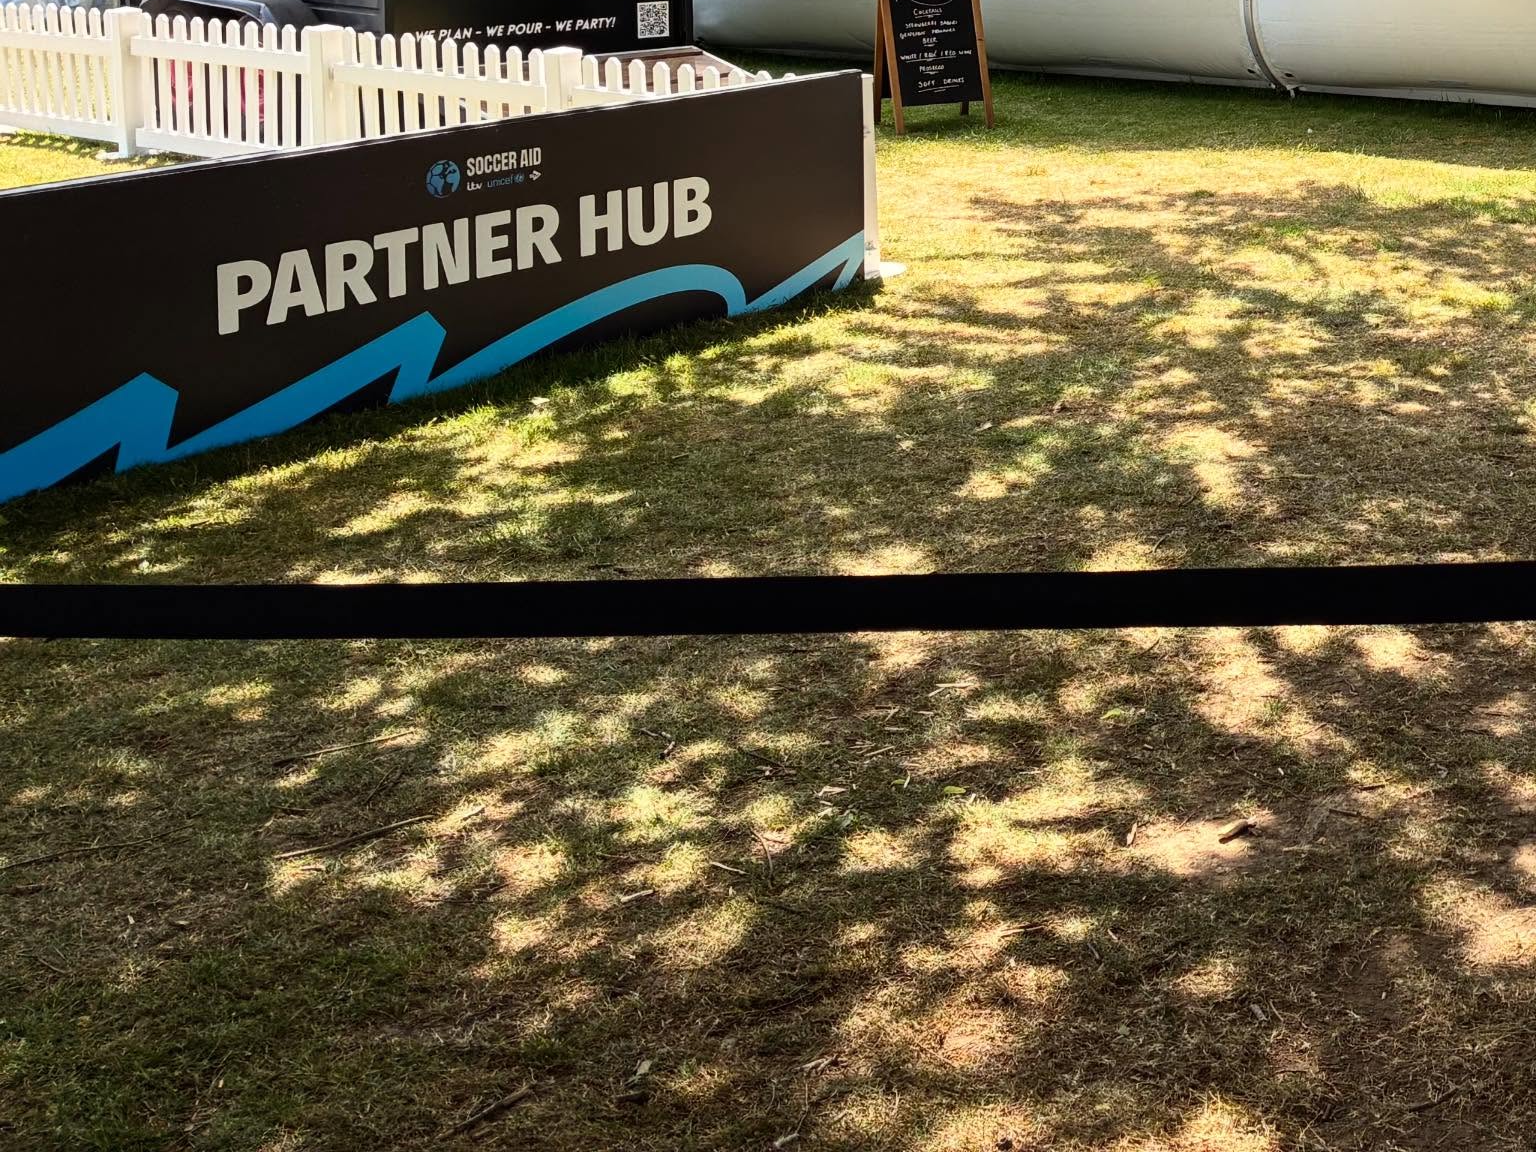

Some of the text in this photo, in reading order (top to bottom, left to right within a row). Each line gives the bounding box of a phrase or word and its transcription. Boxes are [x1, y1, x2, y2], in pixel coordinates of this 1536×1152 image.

[416, 29, 439, 43] WE
[438, 26, 473, 41] PLAN
[486, 24, 505, 38] WE
[507, 21, 543, 36] POUR
[556, 19, 573, 33] WE
[575, 16, 616, 31] PARTY!
[922, 37, 938, 45] BEER
[917, 79, 935, 89] SOFT
[466, 151, 517, 177] SOCCER
[519, 147, 542, 168] AID
[466, 174, 513, 191] itv unicef
[216, 175, 714, 336] PARTNER HUB
